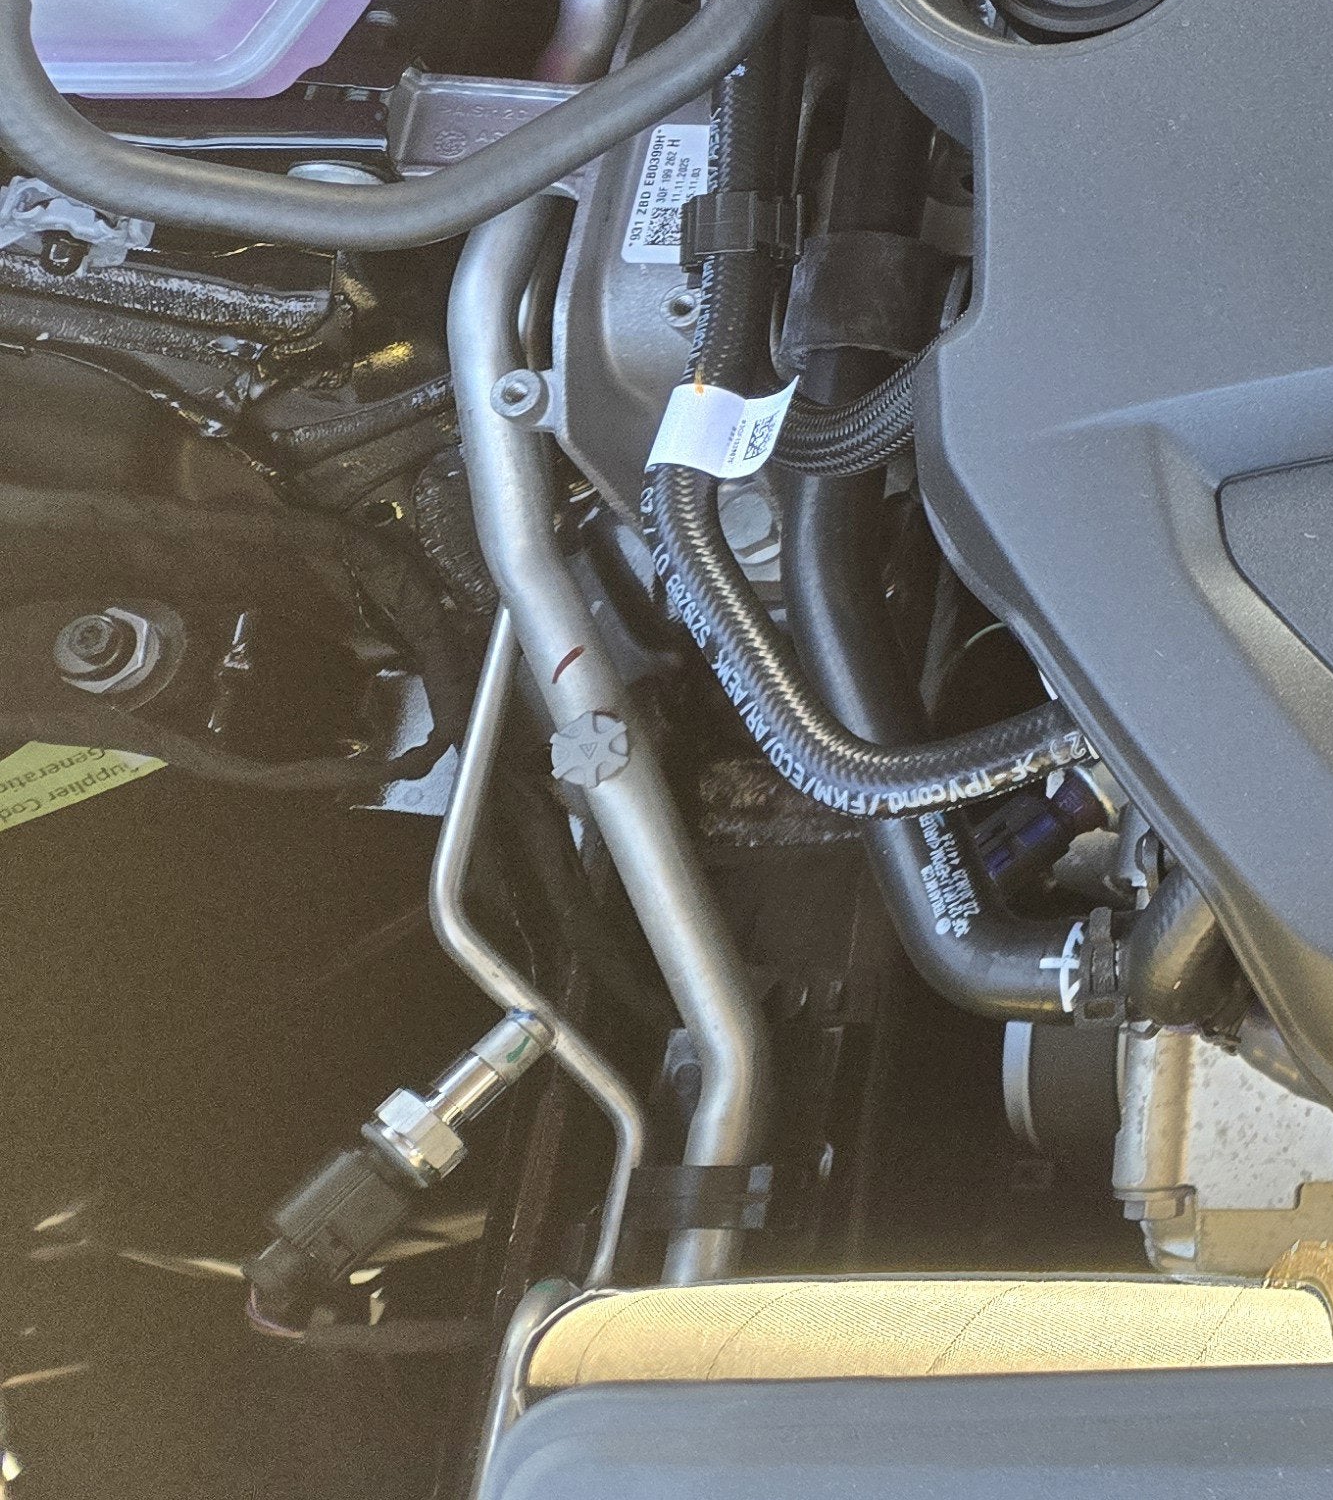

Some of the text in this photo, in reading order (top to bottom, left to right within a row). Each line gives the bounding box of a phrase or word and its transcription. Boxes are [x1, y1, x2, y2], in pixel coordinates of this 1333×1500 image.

[667, 139, 681, 148] H
[667, 151, 677, 166] 262
[671, 157, 689, 202] 11.11.2025
[686, 168, 701, 200] 5.11.03
[636, 191, 651, 214] ZBD
[0, 763, 139, 823] upplier Cod
